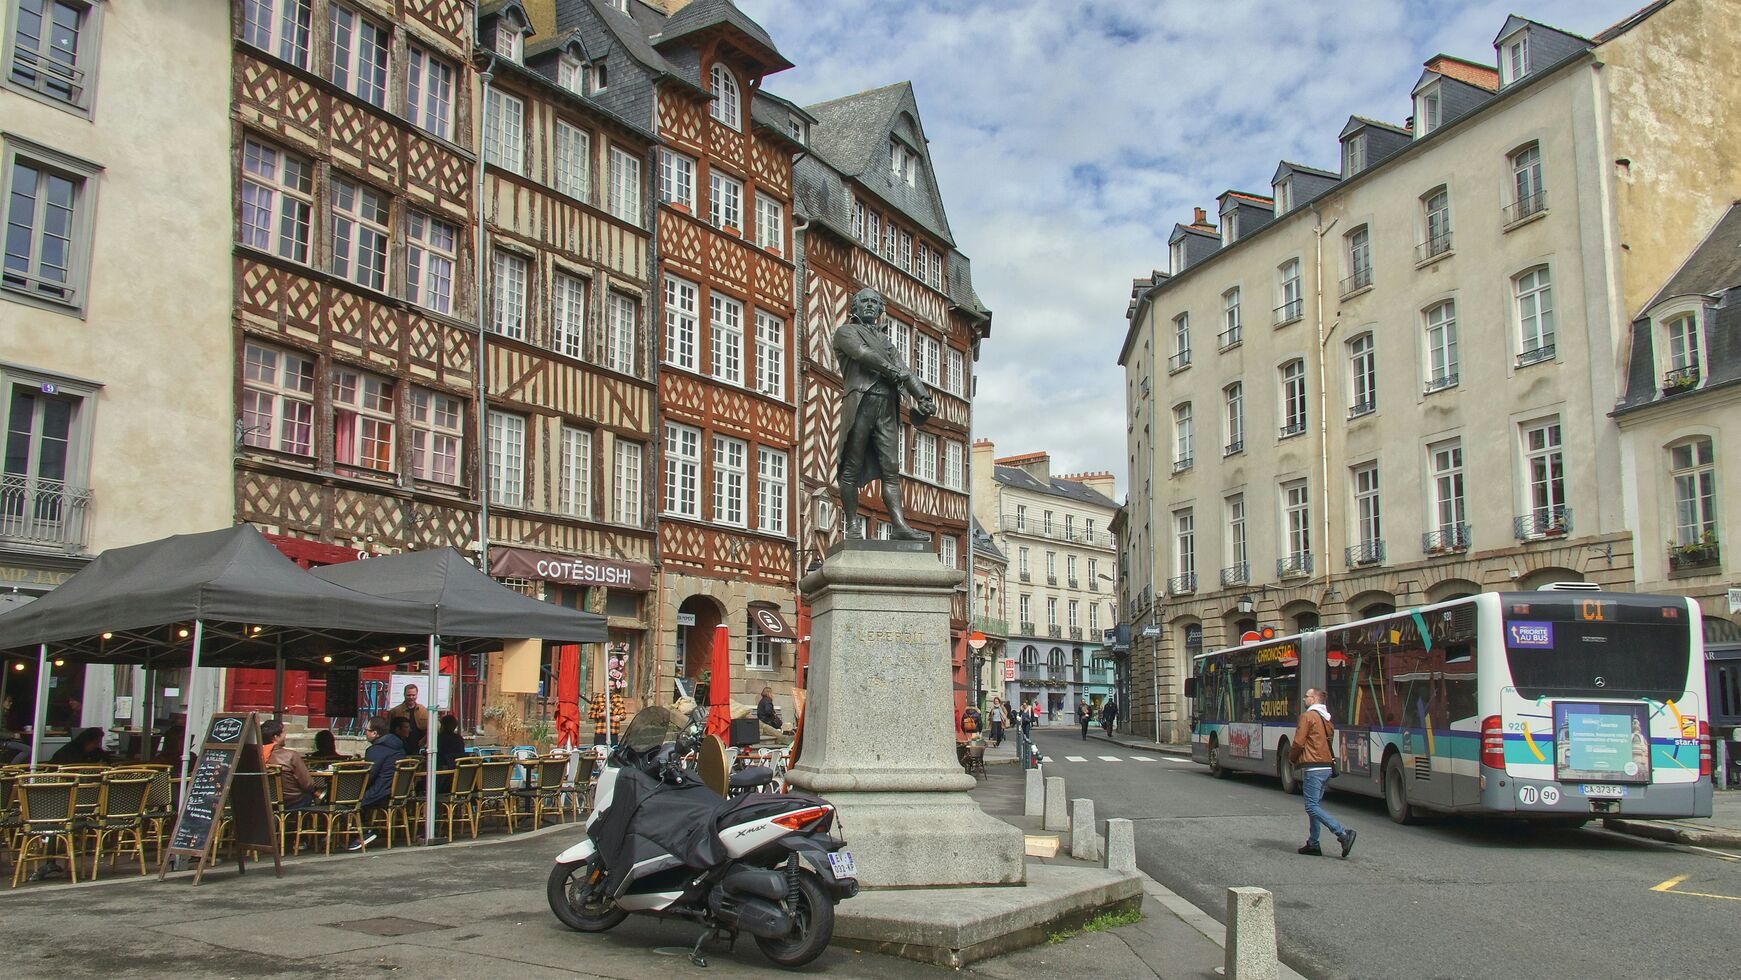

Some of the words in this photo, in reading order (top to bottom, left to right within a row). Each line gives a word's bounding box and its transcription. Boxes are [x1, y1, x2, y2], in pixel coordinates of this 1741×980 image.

[1583, 599, 1603, 620] C1
[1261, 697, 1289, 717] souvent
[1508, 722, 1526, 731] 920
[1674, 738, 1699, 746] star.fr
[1523, 787, 1535, 802] 70
[1543, 791, 1557, 801] 90
